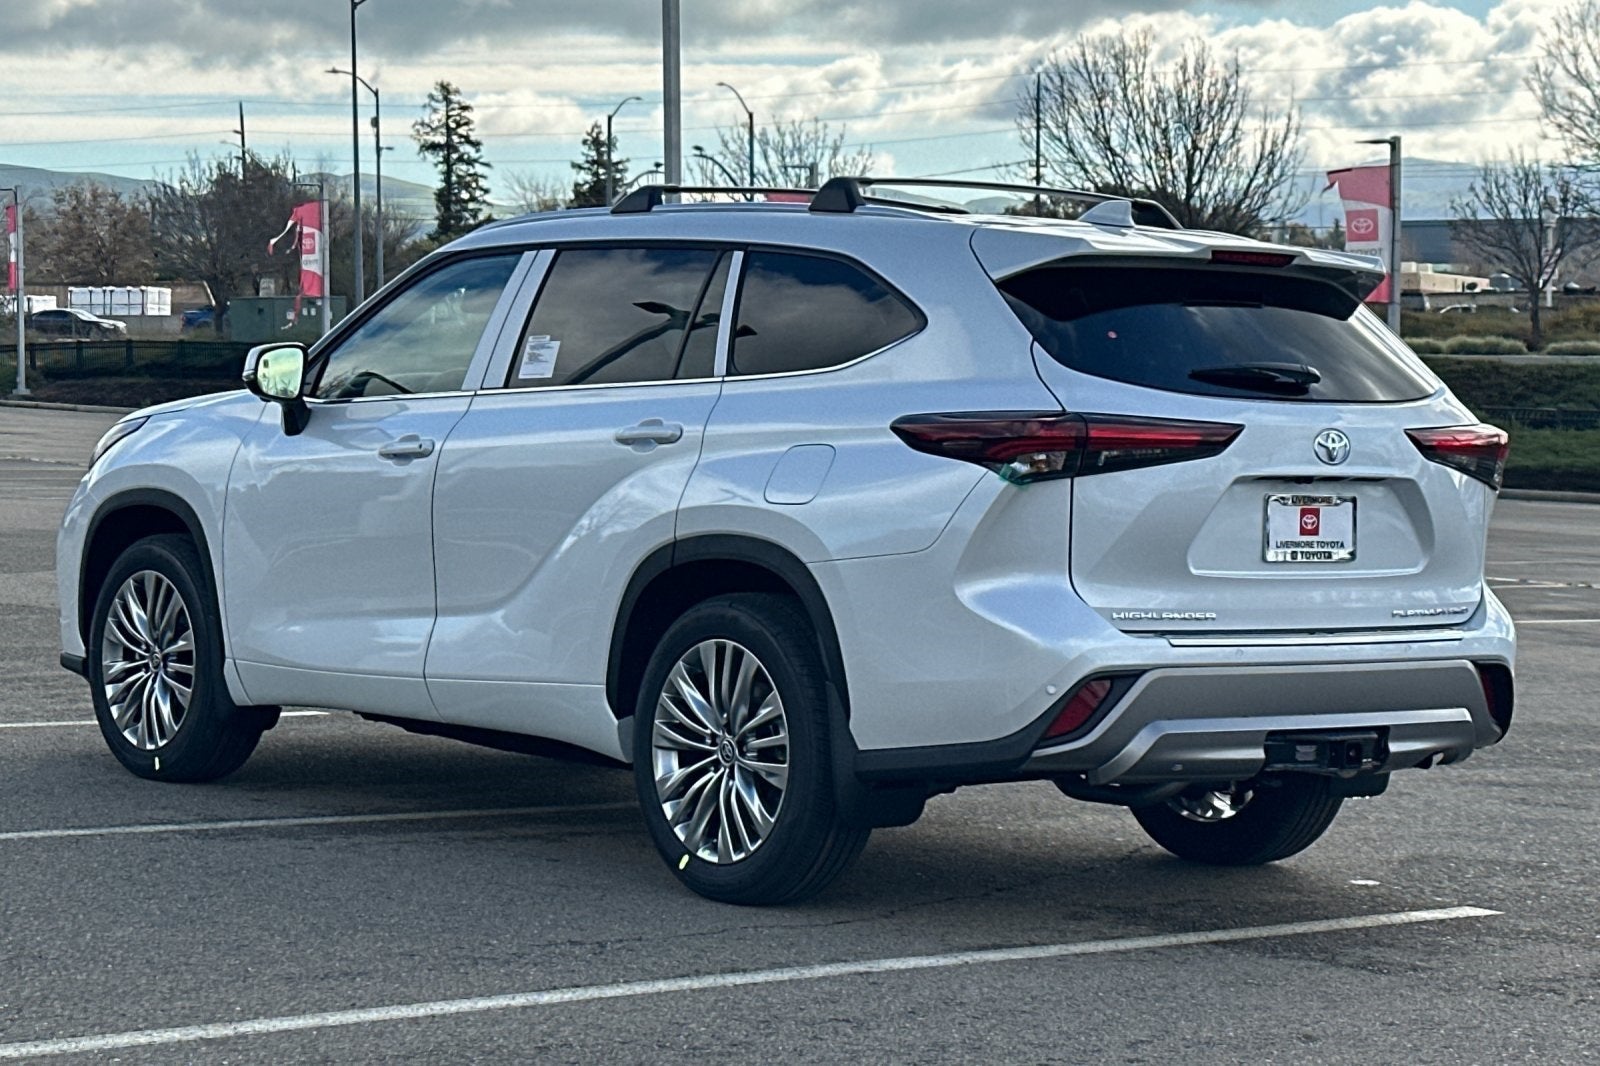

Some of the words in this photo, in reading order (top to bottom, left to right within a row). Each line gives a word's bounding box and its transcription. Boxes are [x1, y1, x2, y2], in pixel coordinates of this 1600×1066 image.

[1275, 541, 1315, 549] LIVERMORE
[1316, 541, 1345, 549] TOYOTA
[1300, 551, 1333, 560] TOYOTA
[1112, 612, 1217, 621] HIGHLANDER
